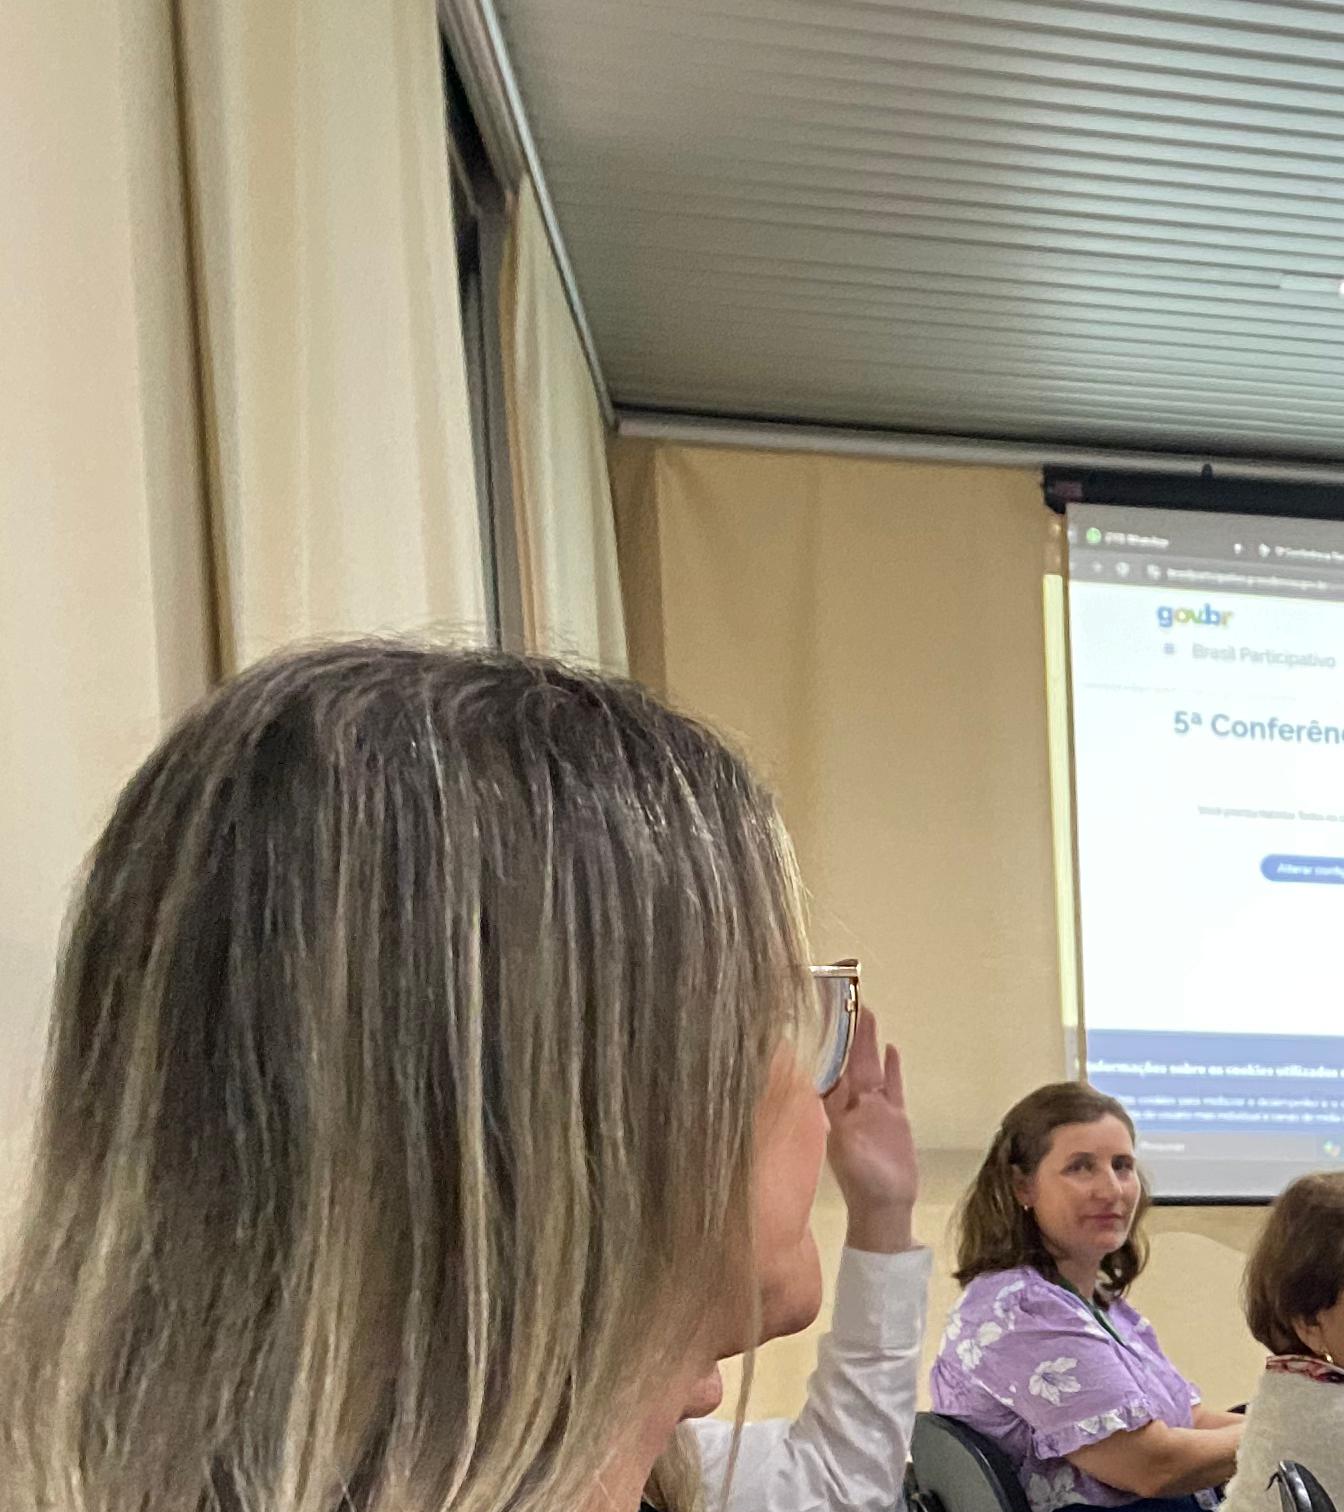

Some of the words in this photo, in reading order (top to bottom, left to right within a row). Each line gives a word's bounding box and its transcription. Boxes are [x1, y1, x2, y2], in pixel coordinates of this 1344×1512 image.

[1192, 643, 1237, 662] Brasil
[1173, 709, 1204, 736] 5ª
[1226, 1063, 1274, 1078] cookies
